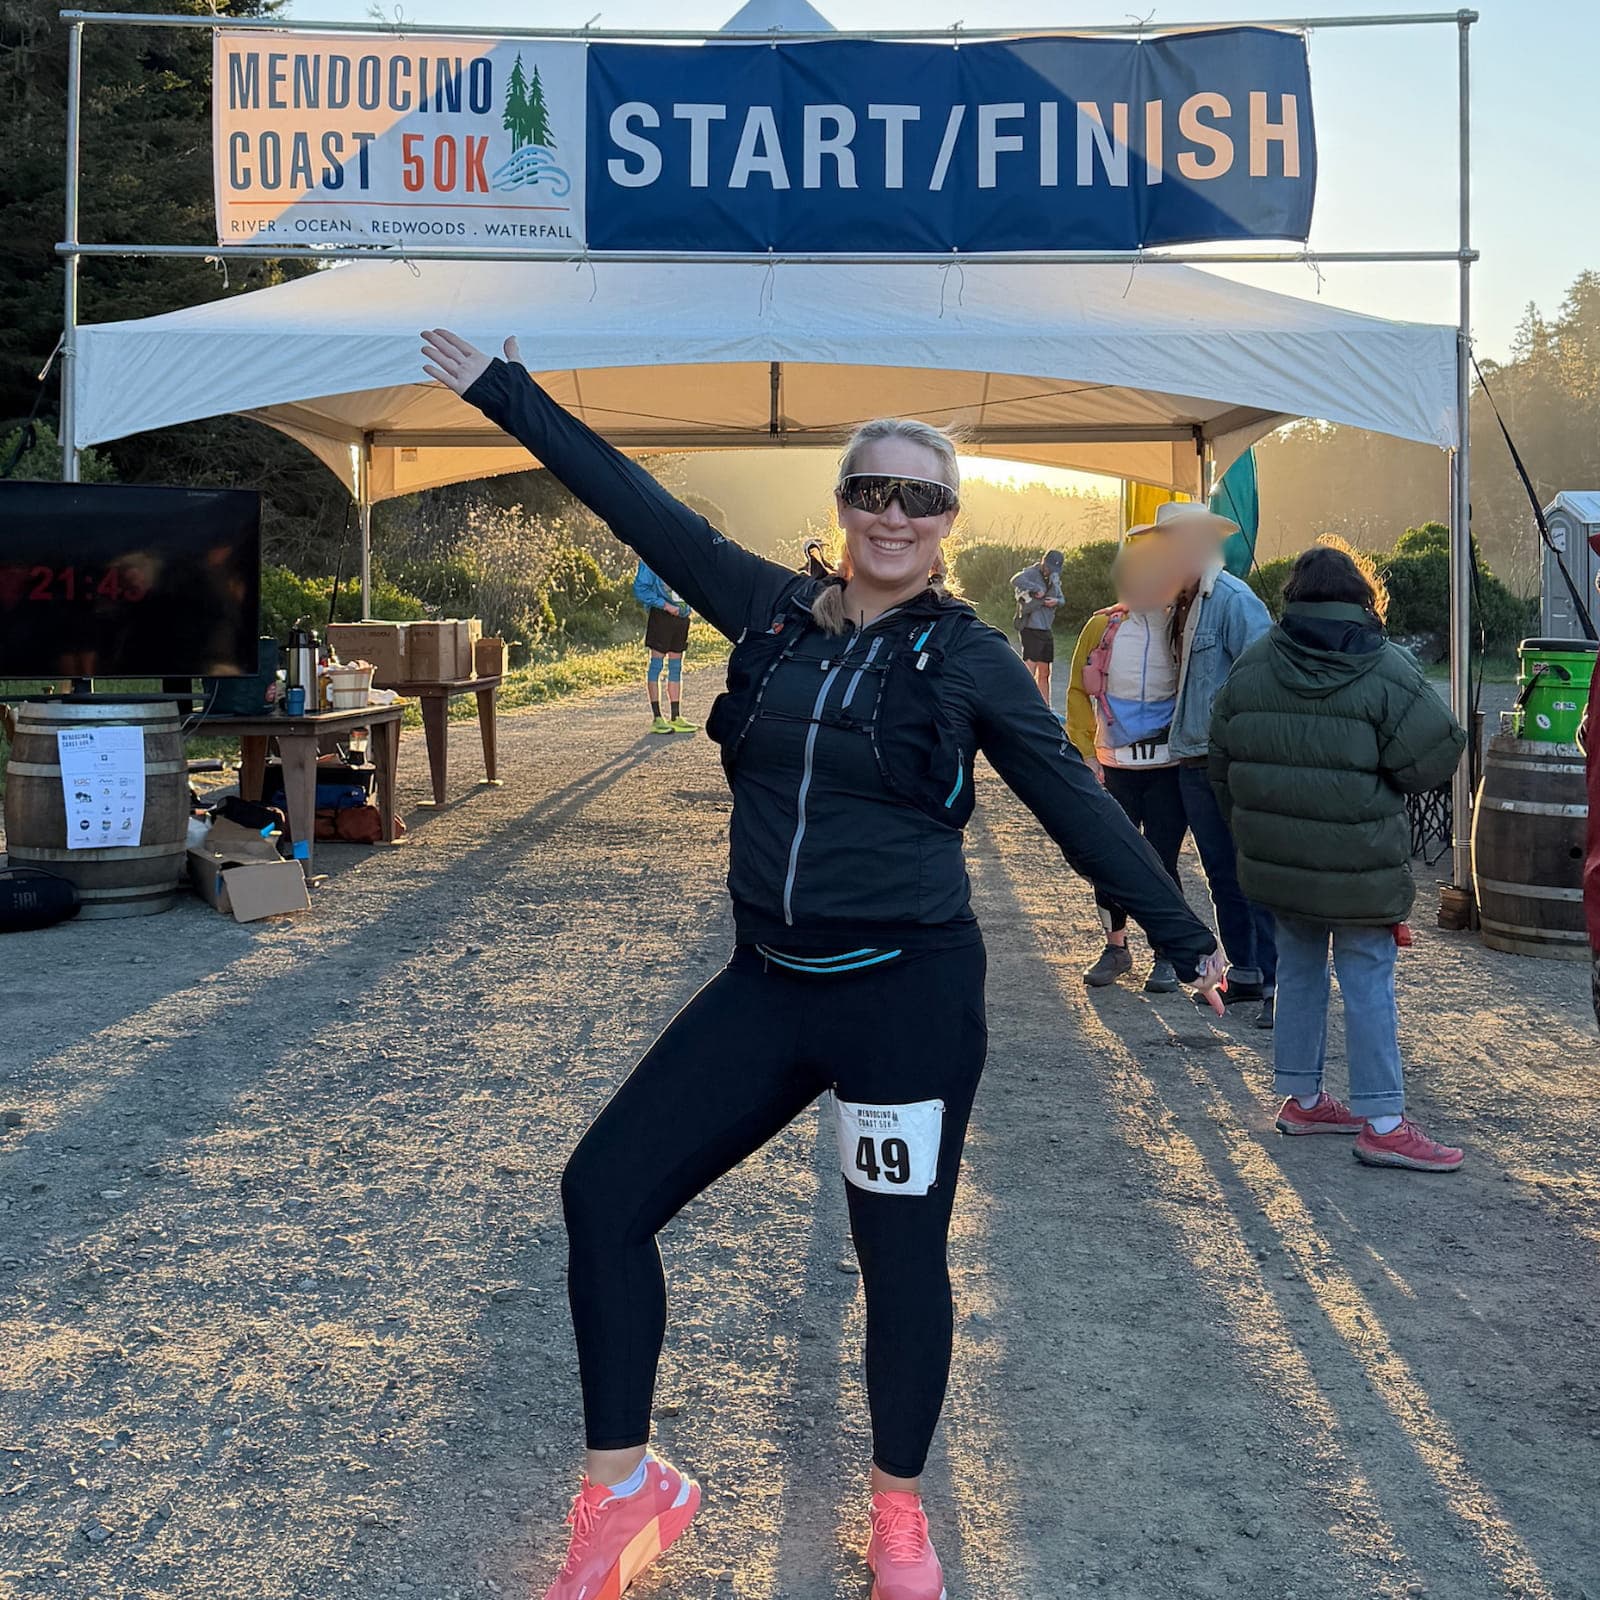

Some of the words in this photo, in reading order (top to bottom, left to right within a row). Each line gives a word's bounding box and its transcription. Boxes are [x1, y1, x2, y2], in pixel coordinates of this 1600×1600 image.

[228, 52, 493, 114] MENDOCINO
[229, 131, 376, 191] COAST
[402, 134, 490, 193] 50K
[606, 91, 1301, 191] START/FINISH
[231, 219, 277, 233] RIVER
[294, 219, 352, 233] OCEAN
[372, 220, 466, 236] REDWOODS
[485, 223, 573, 239] WATERFALL
[858, 1109, 891, 1118] MENDOCINO
[858, 1119, 877, 1128] COAST
[855, 1136, 911, 1185] 49
